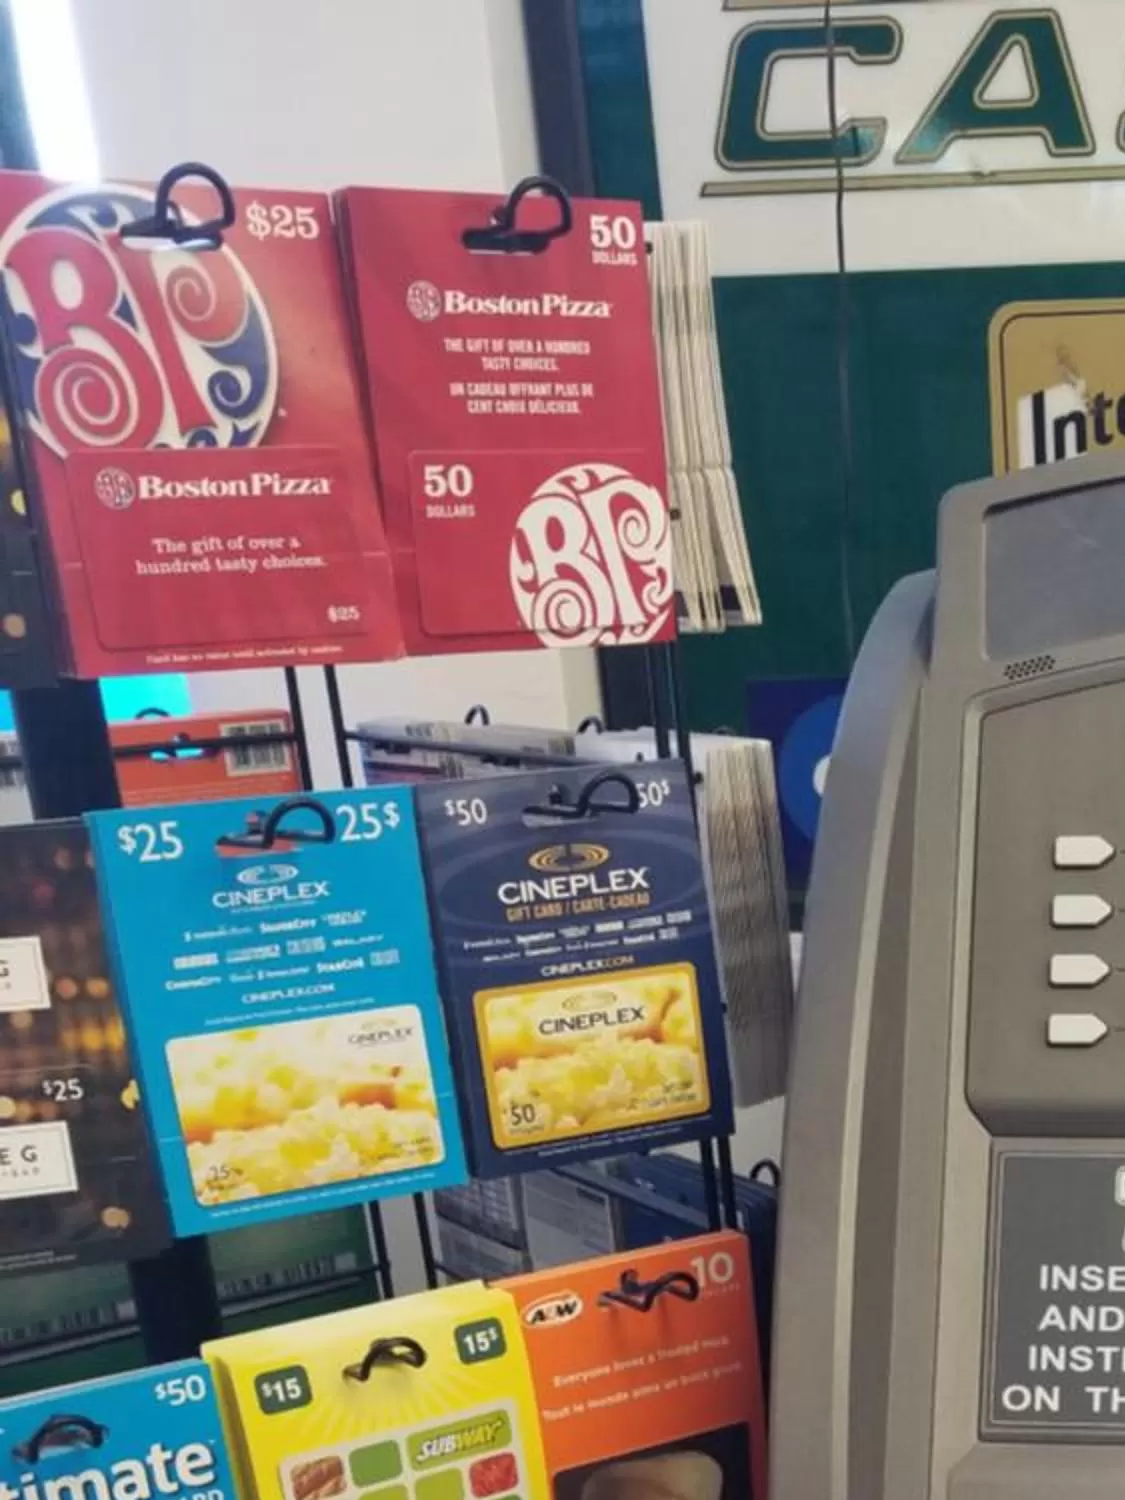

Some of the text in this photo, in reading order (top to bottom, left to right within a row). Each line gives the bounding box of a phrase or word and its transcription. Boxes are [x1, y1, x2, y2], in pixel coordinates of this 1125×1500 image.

[247, 200, 321, 241] $25
[589, 213, 637, 250] 50
[444, 289, 611, 319] Boston Pizza
[138, 472, 332, 500] Boston Pizza
[424, 466, 472, 497] 50
[152, 535, 300, 556] The gift of over a
[136, 557, 211, 576] hundred
[335, 802, 400, 841] 25$
[445, 798, 487, 826] $50
[117, 822, 183, 862] $25
[212, 880, 331, 908] CINEPLEX
[498, 867, 649, 905] CINEPLEX
[538, 1007, 646, 1036] CINEPLEX
[42, 1078, 84, 1101] $25
[689, 1252, 735, 1290] 10
[1038, 1305, 1125, 1332] AND
[462, 1327, 498, 1355] 15$
[154, 1375, 206, 1407] $50
[261, 1377, 302, 1403] $15
[1002, 1384, 1060, 1412] ON
[416, 1419, 504, 1463] SUBWAY
